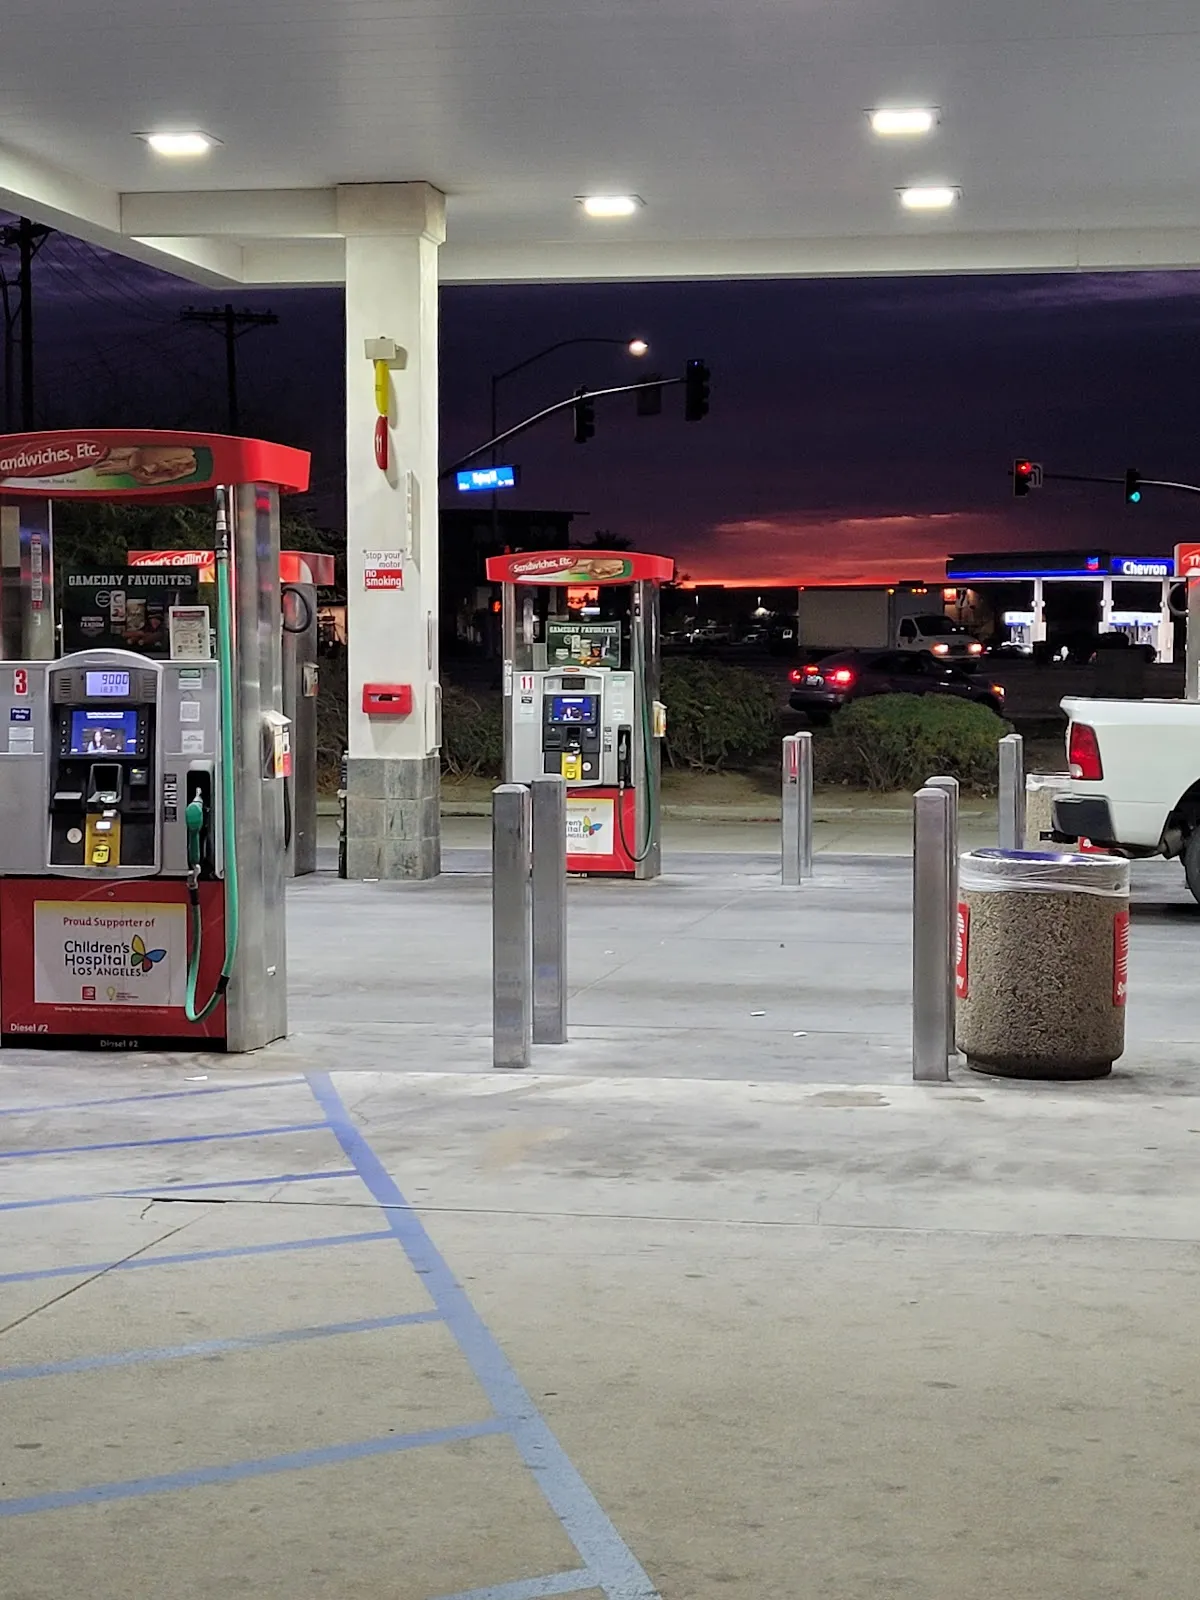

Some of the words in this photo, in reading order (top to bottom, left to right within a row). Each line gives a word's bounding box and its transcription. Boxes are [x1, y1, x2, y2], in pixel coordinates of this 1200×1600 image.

[0, 448, 74, 470] andwiches,
[77, 443, 100, 458] Etc.
[366, 552, 382, 562] stop
[384, 552, 400, 561] your
[1123, 561, 1167, 576] Chevron
[68, 575, 123, 586] GAMEDAY
[127, 575, 192, 586] FAVORITES
[366, 575, 402, 589] smoking
[15, 669, 27, 694] 3
[521, 675, 533, 690] 11
[63, 917, 92, 926] Proud
[94, 917, 143, 928] Supporter
[145, 917, 155, 927] of
[64, 940, 130, 954] Children's
[64, 954, 126, 969] Hospital
[72, 967, 92, 976] LOS
[96, 968, 141, 977] ANGELES
[10, 1022, 37, 1032] Diesel
[37, 1023, 49, 1032] #2
